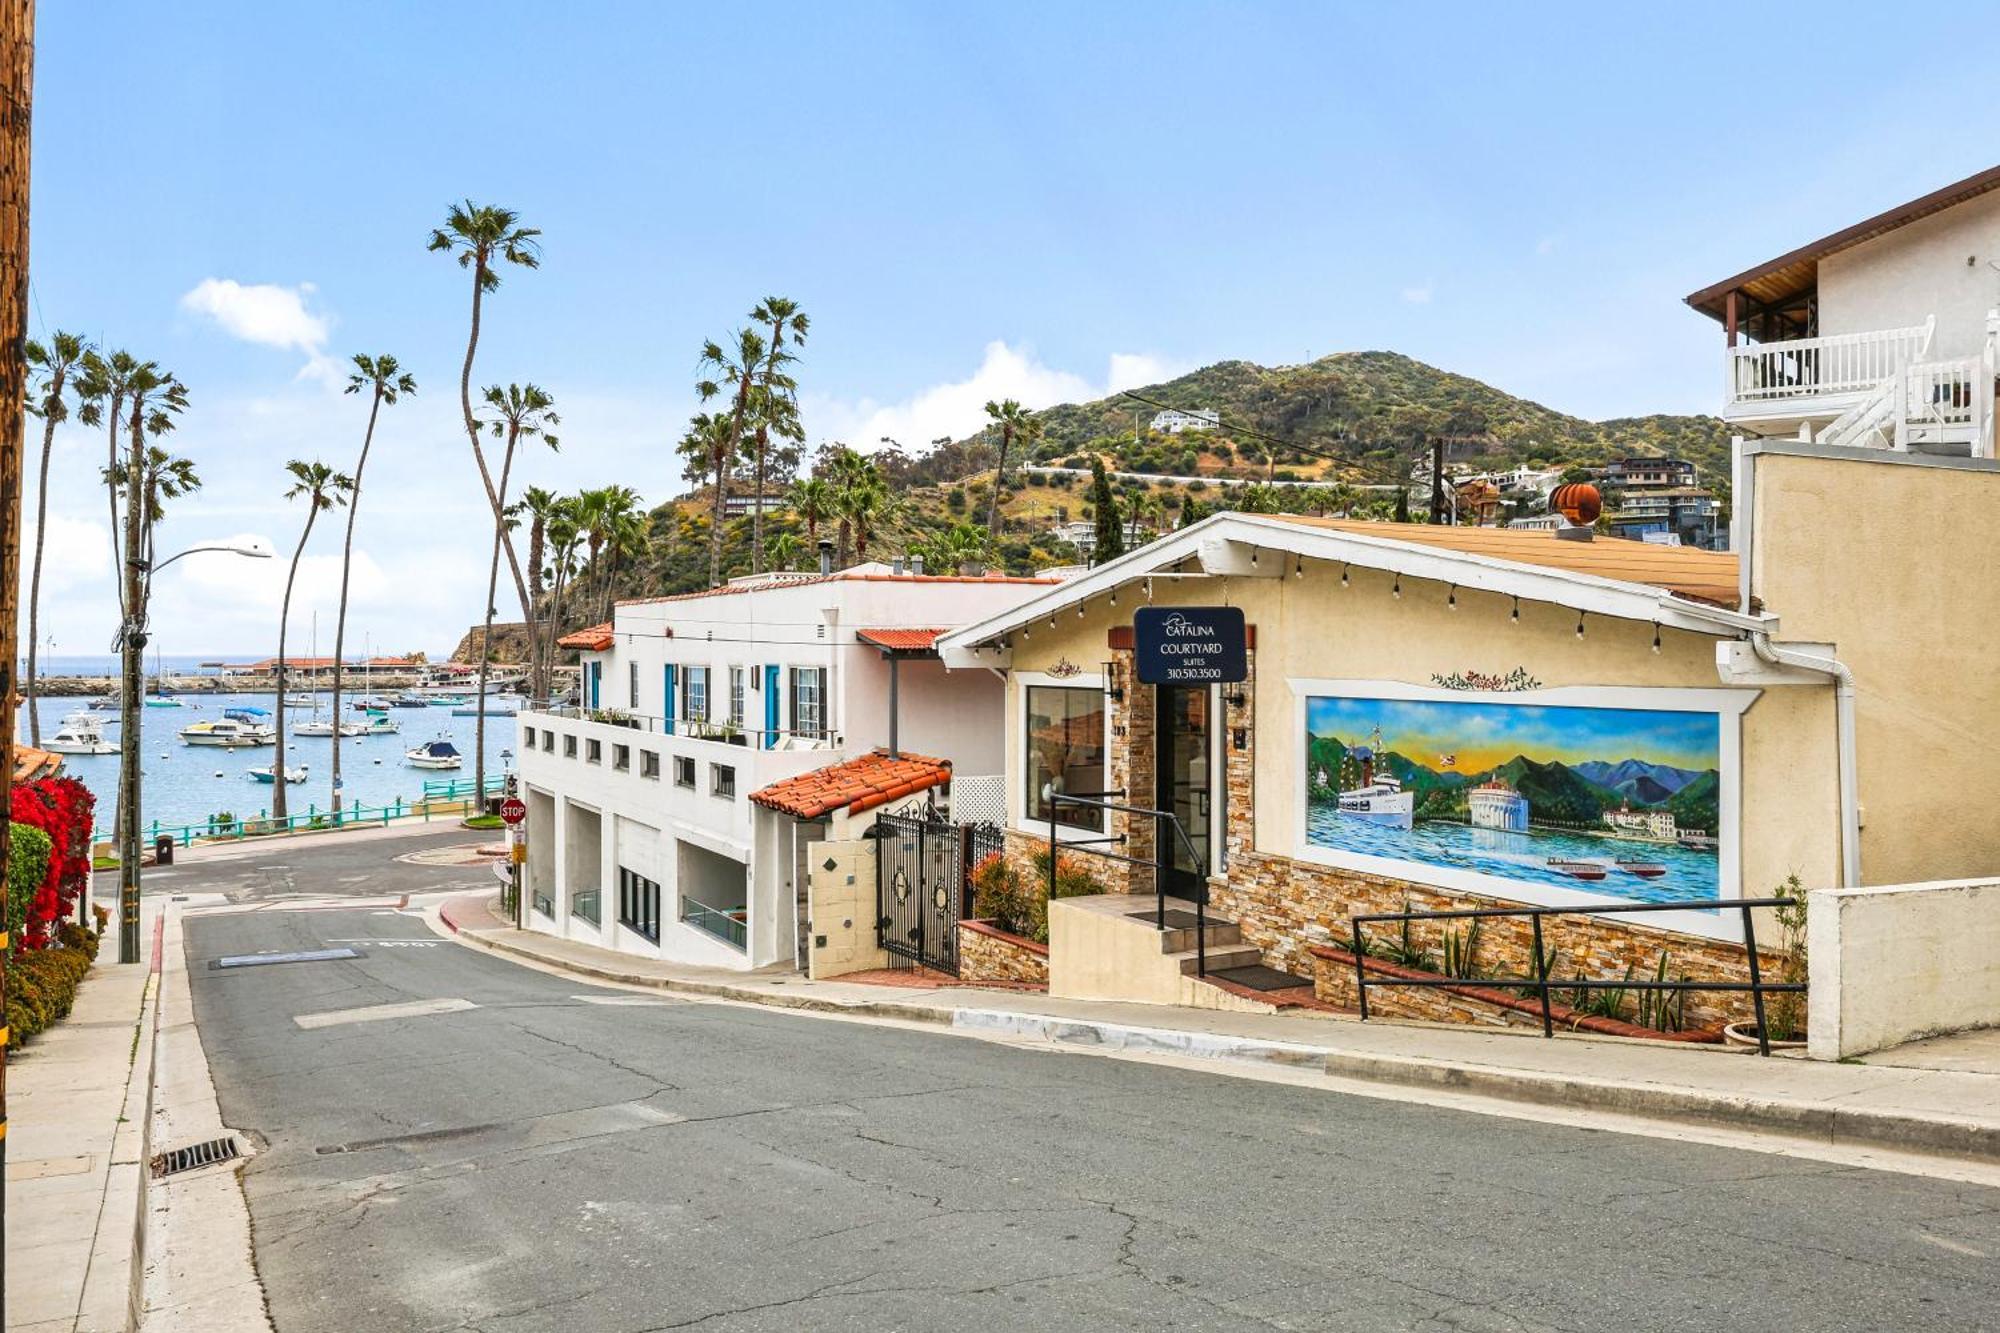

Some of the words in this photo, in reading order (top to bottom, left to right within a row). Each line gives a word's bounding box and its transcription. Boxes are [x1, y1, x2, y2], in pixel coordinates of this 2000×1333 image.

[1166, 625, 1215, 637] CATALINA
[1160, 643, 1223, 655] COURTYARD
[1183, 657, 1206, 666] SUITES
[1167, 668, 1221, 680] 310.510.3500
[502, 807, 525, 817] STOP
